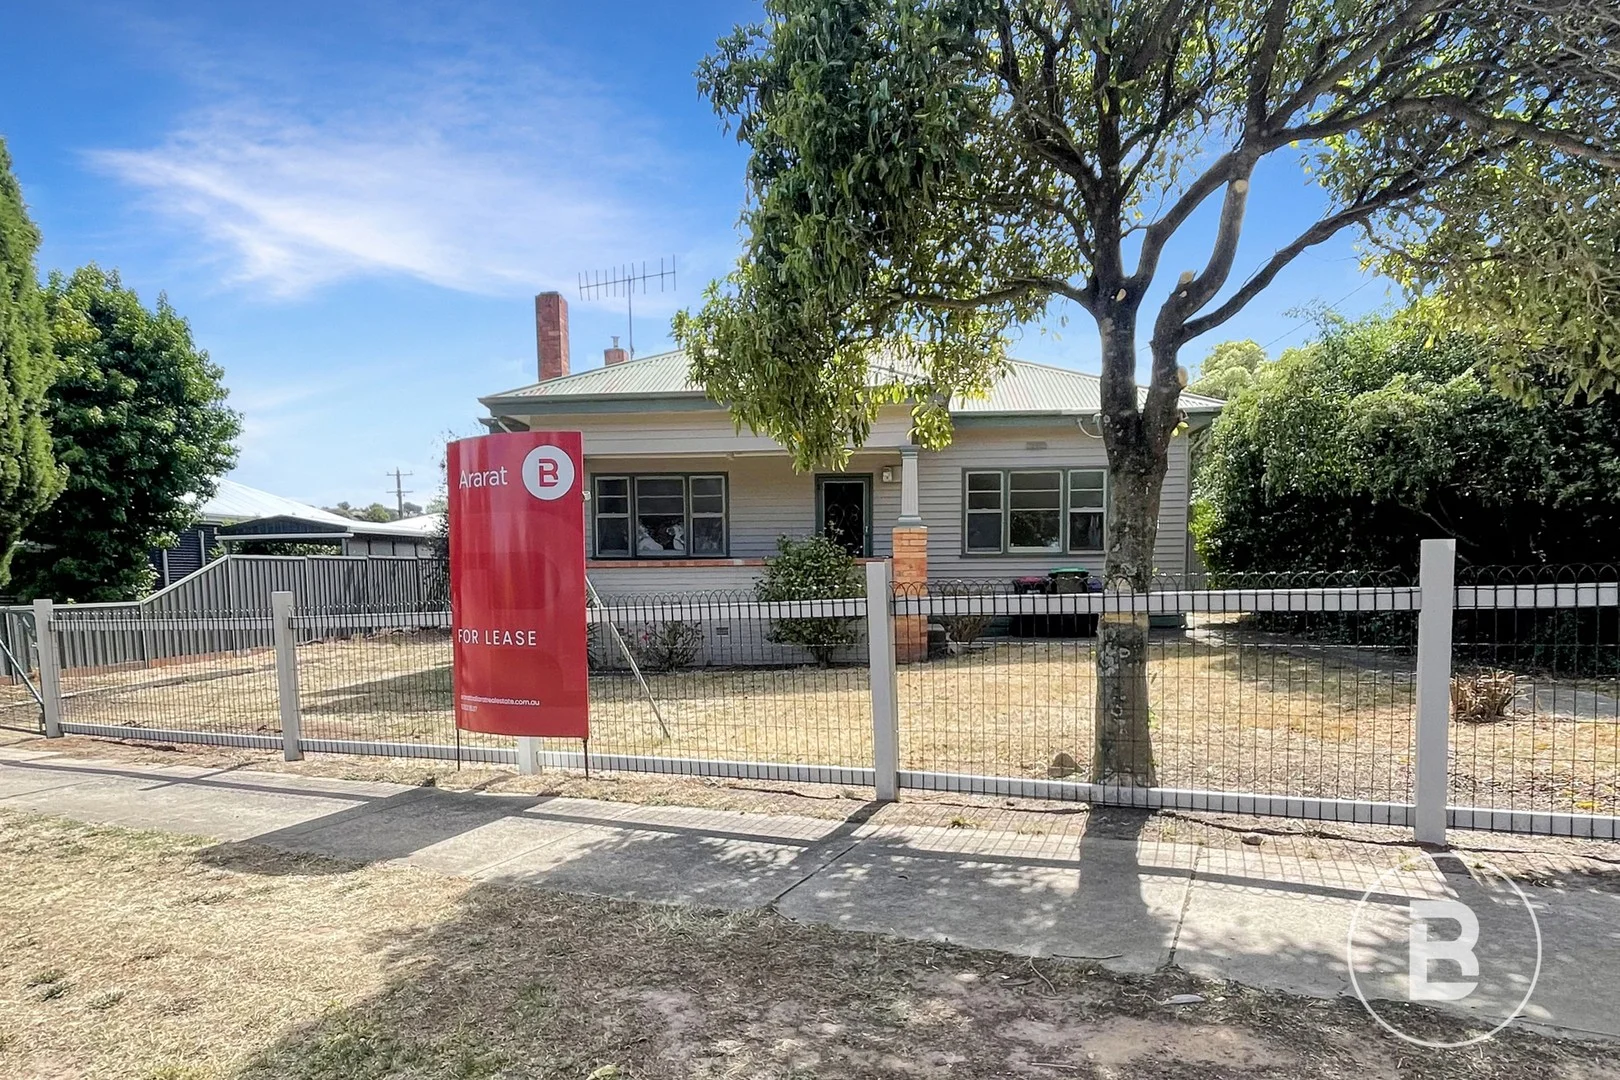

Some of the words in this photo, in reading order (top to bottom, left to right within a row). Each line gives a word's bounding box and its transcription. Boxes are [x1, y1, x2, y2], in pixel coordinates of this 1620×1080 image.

[458, 466, 508, 490] Ararat
[458, 628, 479, 645] FOR
[485, 629, 537, 646] LEASE
